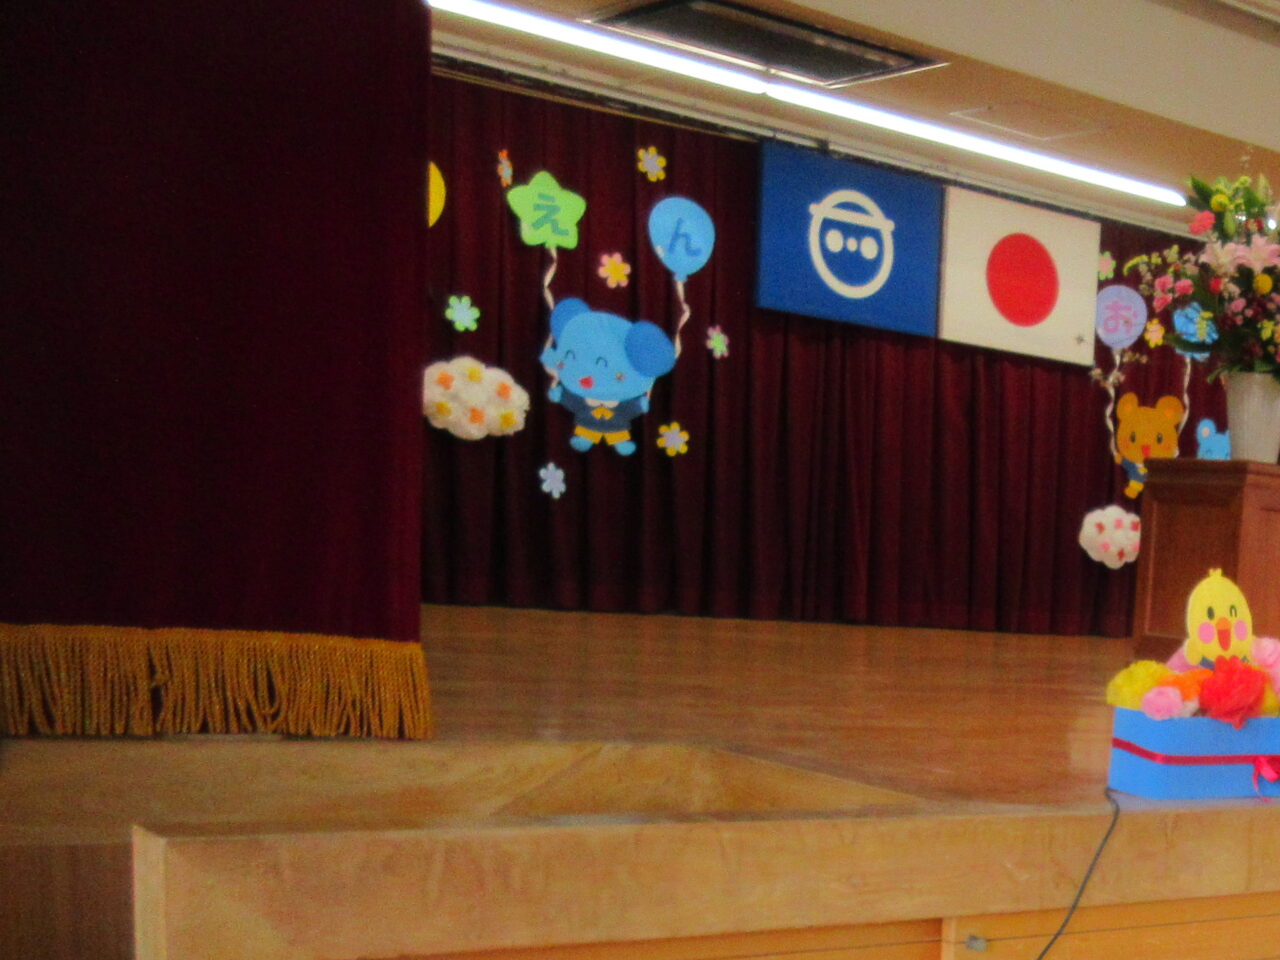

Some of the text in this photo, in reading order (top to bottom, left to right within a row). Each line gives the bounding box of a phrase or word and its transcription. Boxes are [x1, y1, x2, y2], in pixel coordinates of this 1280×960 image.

[532, 192, 569, 237] え
[668, 217, 701, 257] ん
[1103, 300, 1138, 335] お
